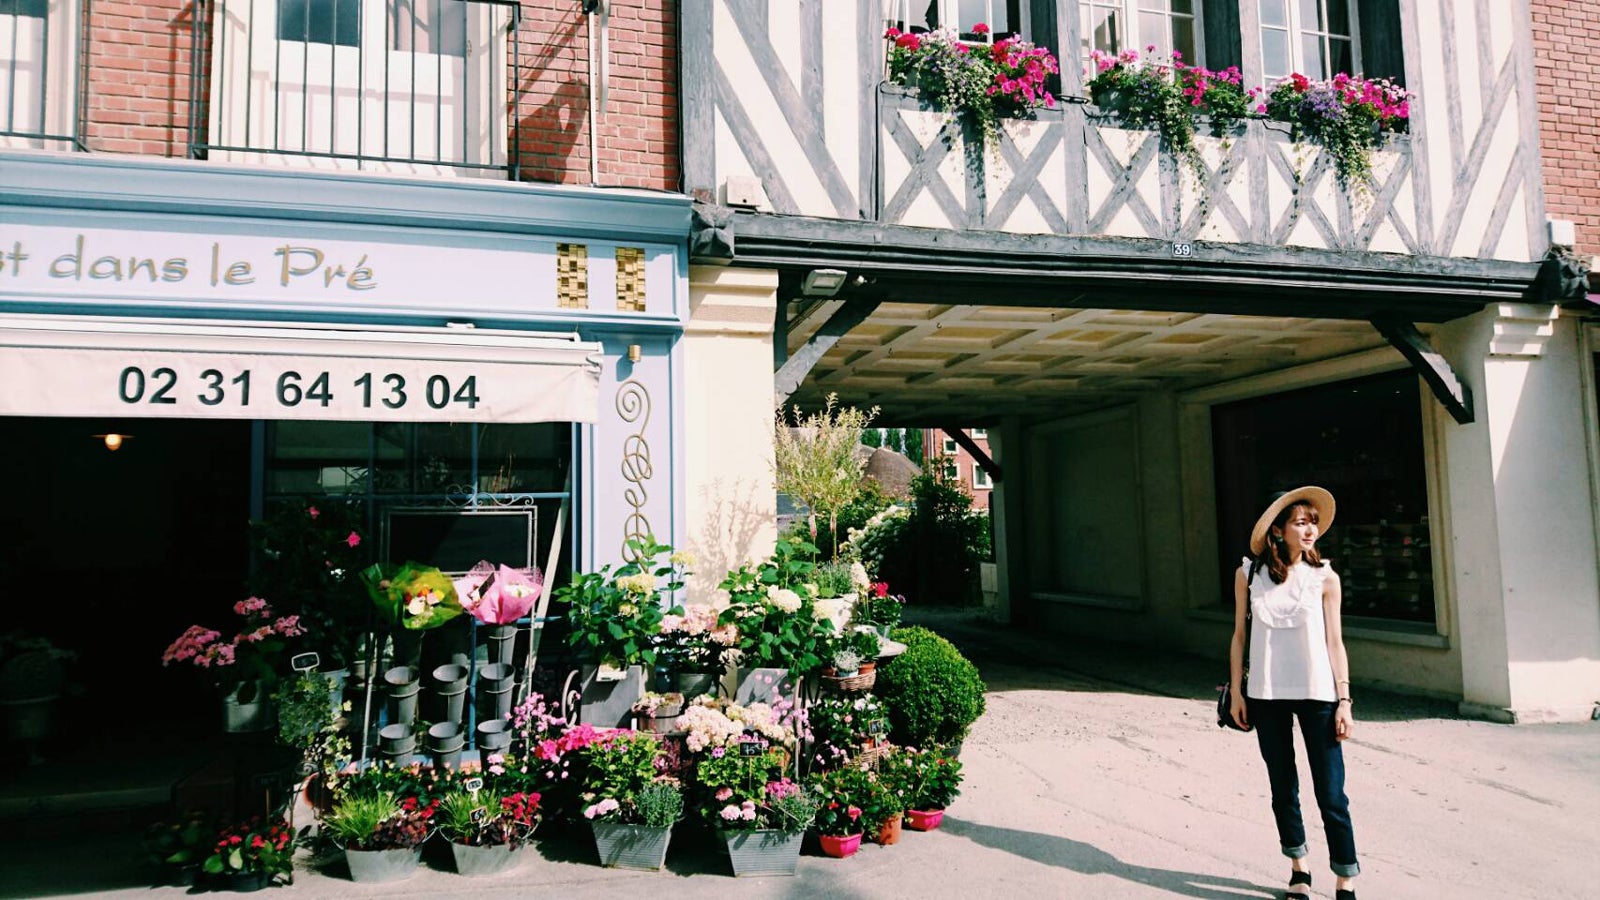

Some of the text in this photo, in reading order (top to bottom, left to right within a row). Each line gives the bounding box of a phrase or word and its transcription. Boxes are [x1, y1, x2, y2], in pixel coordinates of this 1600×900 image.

[0, 235, 378, 291] t dans le Pré
[1175, 245, 1190, 255] 39
[120, 366, 480, 409] 02 31 64 13 04
